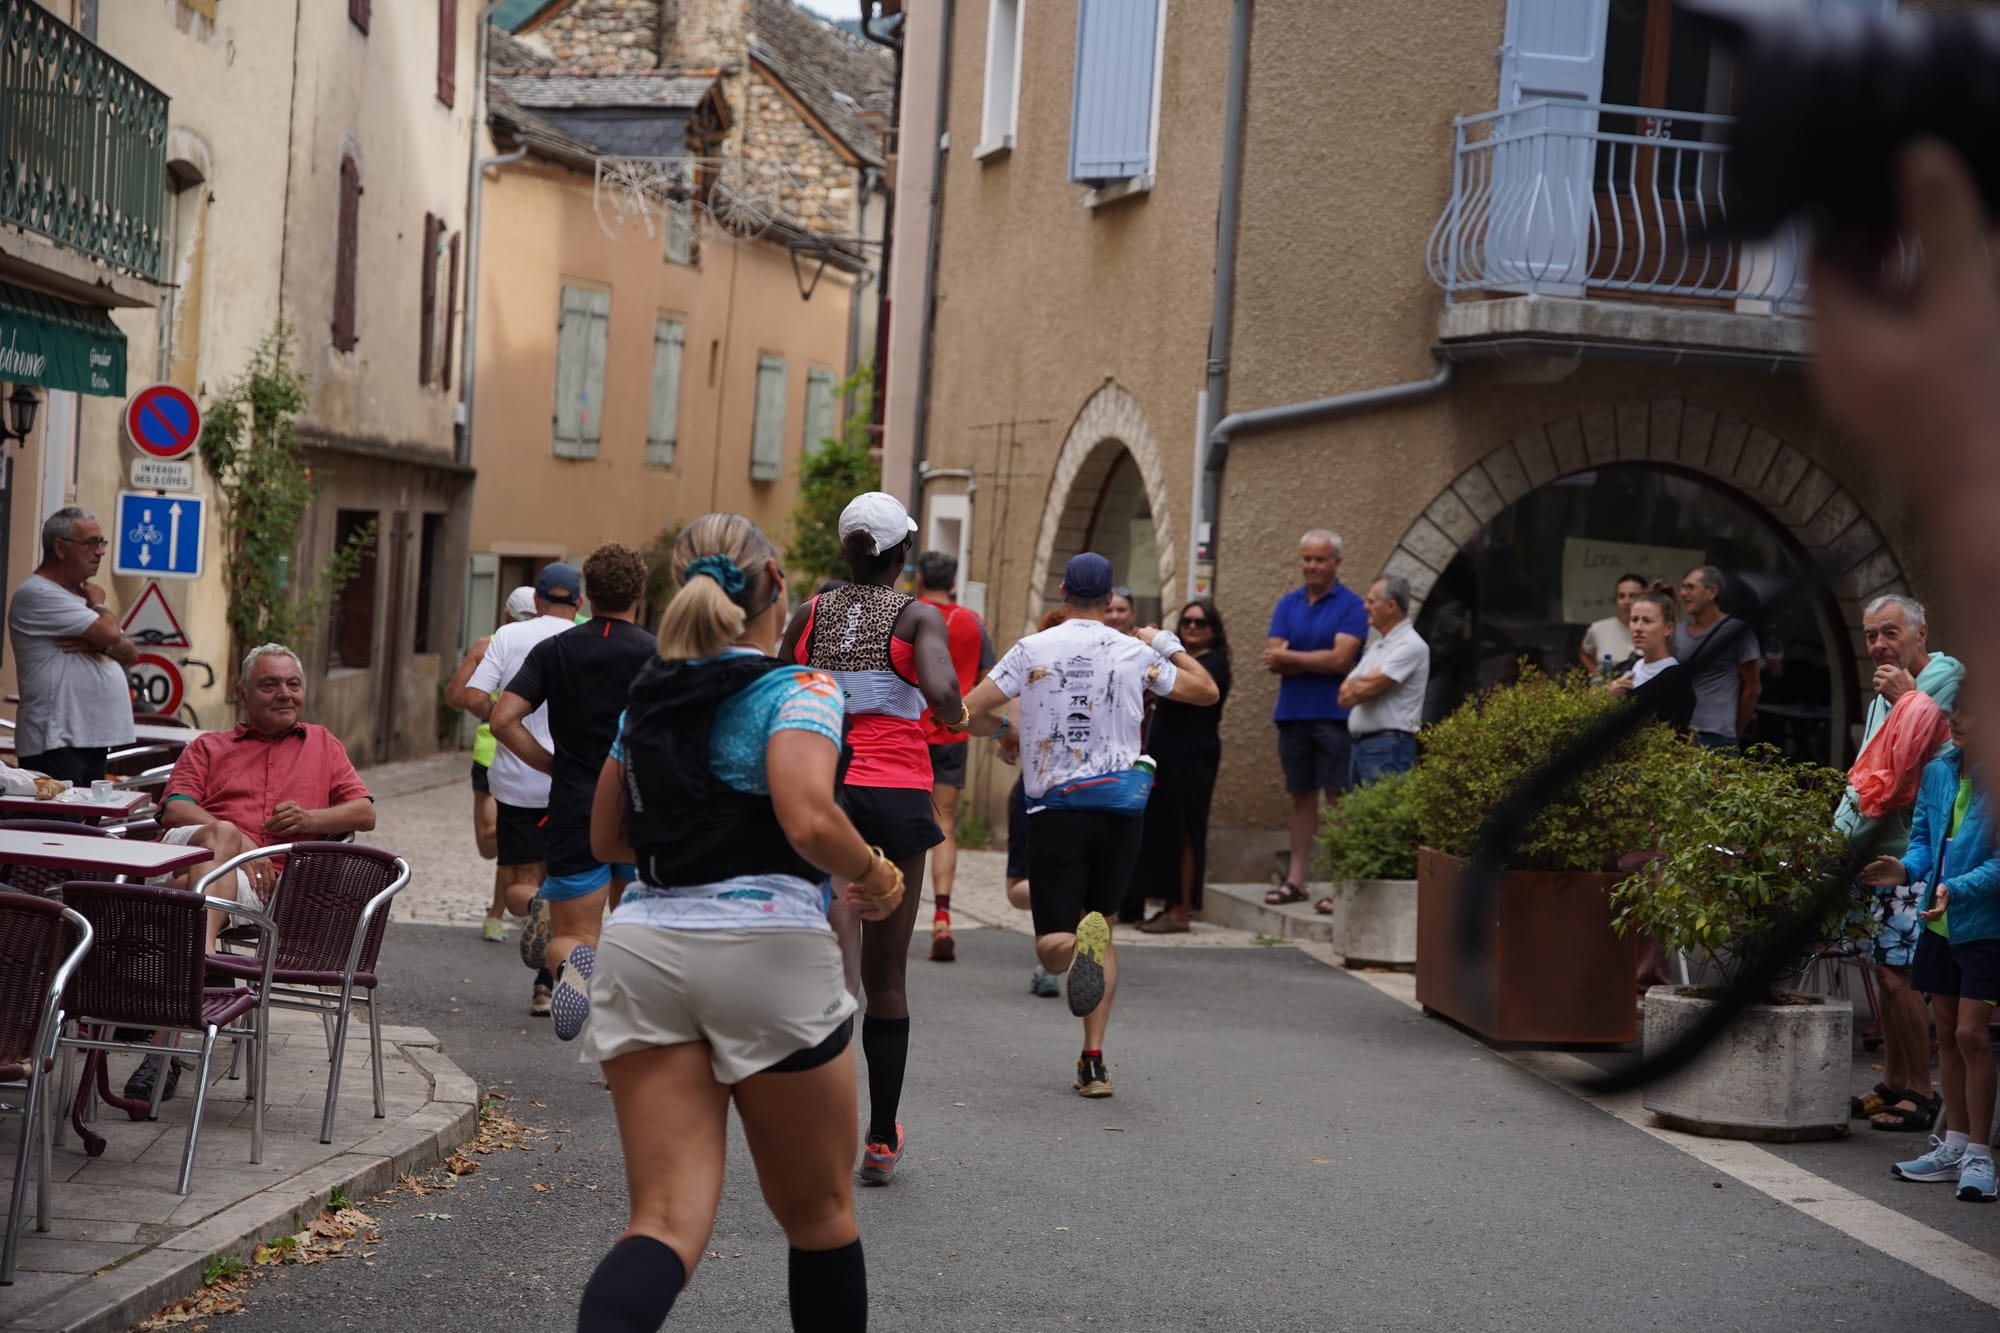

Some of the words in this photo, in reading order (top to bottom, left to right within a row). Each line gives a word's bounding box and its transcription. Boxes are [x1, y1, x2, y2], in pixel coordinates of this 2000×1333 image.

[0, 327, 47, 377] odrome
[140, 463, 182, 474] INTERDIT
[134, 474, 150, 484] DES
